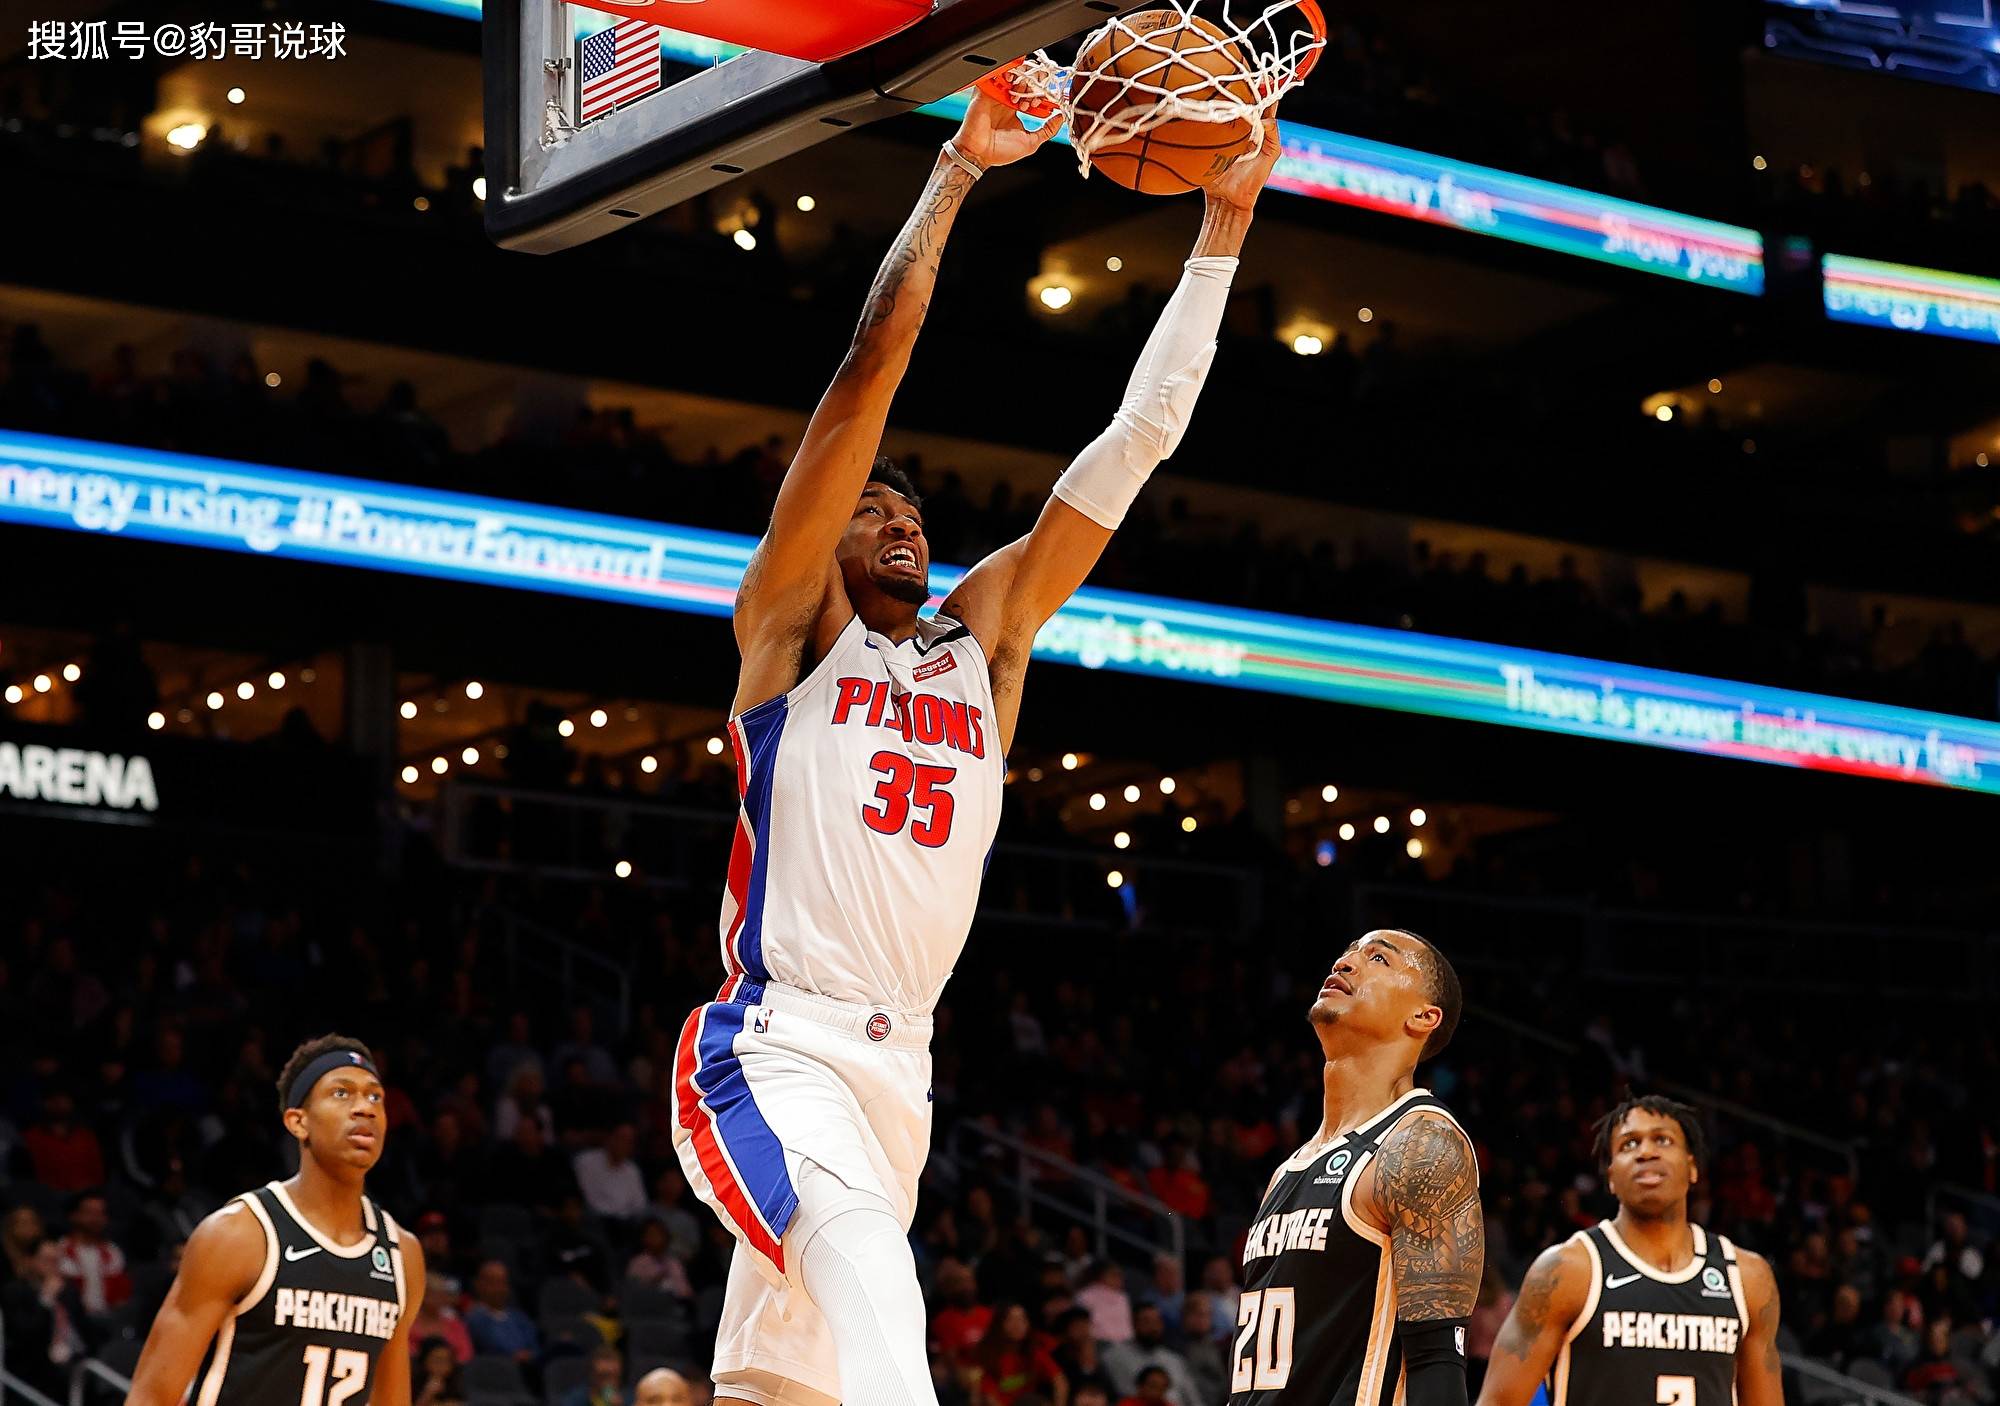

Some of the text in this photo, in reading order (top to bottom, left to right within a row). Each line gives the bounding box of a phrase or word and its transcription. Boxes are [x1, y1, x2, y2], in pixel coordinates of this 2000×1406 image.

[151, 478, 283, 550] using
[913, 656, 950, 675] Flagstar
[1139, 619, 1247, 677] Power
[1499, 664, 1598, 723] There
[1600, 678, 1632, 728] is
[1634, 696, 1737, 742] power
[1835, 731, 1921, 779] every
[0, 741, 159, 811] ARENA
[862, 750, 957, 848] 35
[274, 1288, 400, 1340] PEACHTREE
[1231, 1287, 1296, 1394] 20
[1603, 1311, 1739, 1354] PEACHTREE
[300, 1345, 369, 1406] 12
